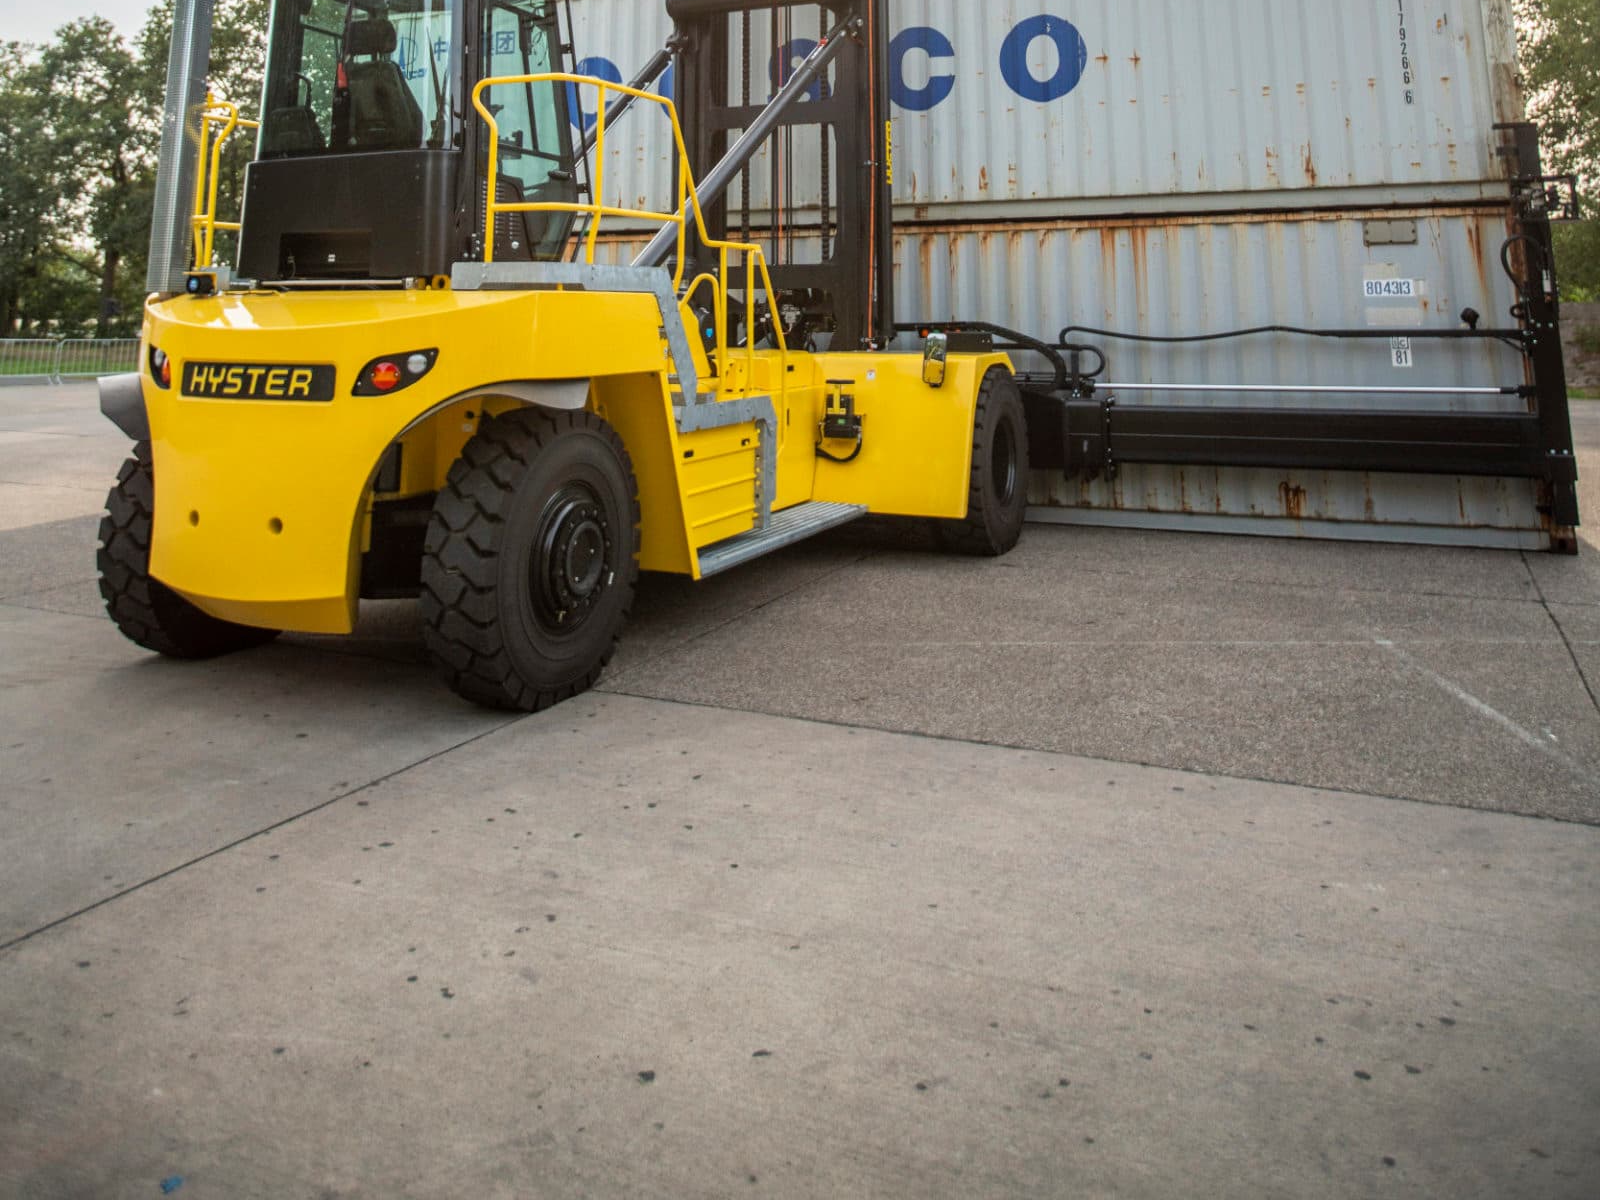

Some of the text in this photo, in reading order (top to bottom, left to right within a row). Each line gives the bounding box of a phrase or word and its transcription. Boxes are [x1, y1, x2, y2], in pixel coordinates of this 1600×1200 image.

[1397, 0, 1411, 85] 179266
[1366, 280, 1411, 295] 804313
[1395, 350, 1408, 365] 81
[189, 365, 314, 397] HYSTER
